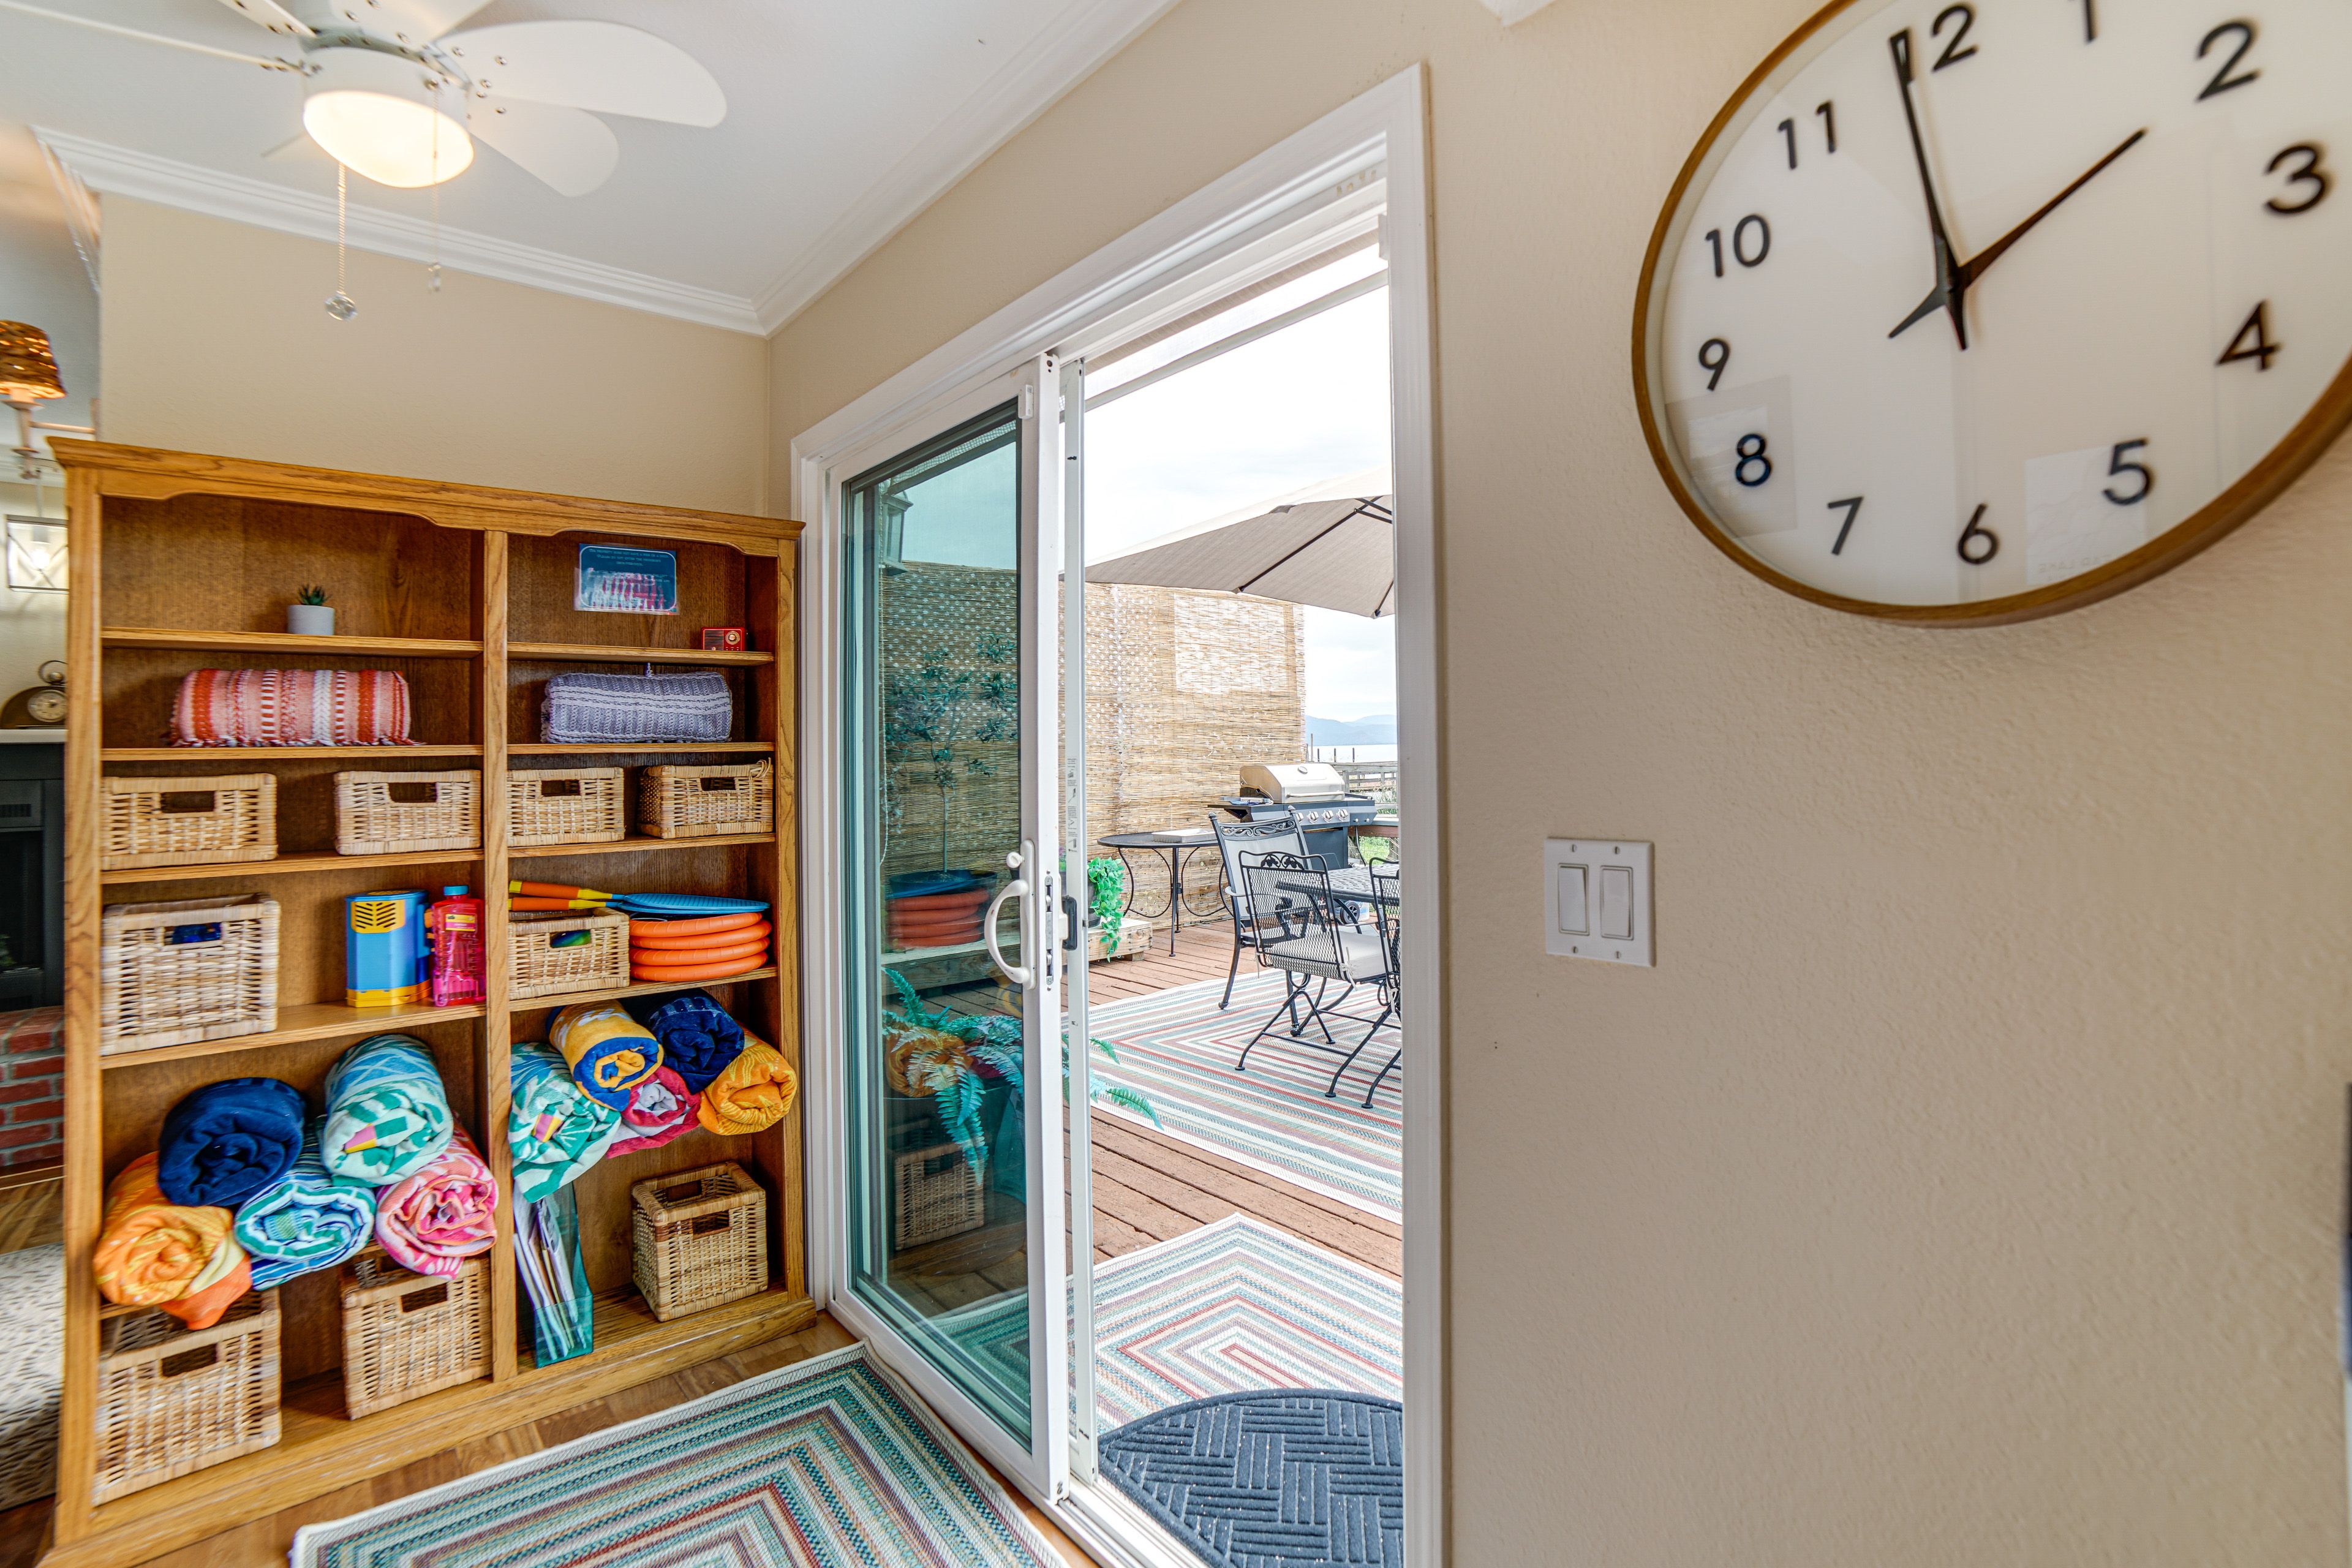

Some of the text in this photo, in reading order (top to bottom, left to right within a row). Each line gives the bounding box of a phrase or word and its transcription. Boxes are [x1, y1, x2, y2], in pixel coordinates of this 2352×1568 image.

[1889, 2, 1978, 82] 12
[2082, 0, 2097, 43] 1
[2195, 18, 2260, 102] 2
[1778, 101, 1836, 170] 11
[2264, 142, 2334, 216] 3
[1705, 214, 1771, 278] 10
[1698, 339, 1730, 391] 9
[2216, 301, 2280, 371] 4
[1735, 433, 1773, 486] 8
[2103, 439, 2155, 505] 5
[1828, 497, 1863, 555] 7
[1957, 503, 1999, 565] 6
